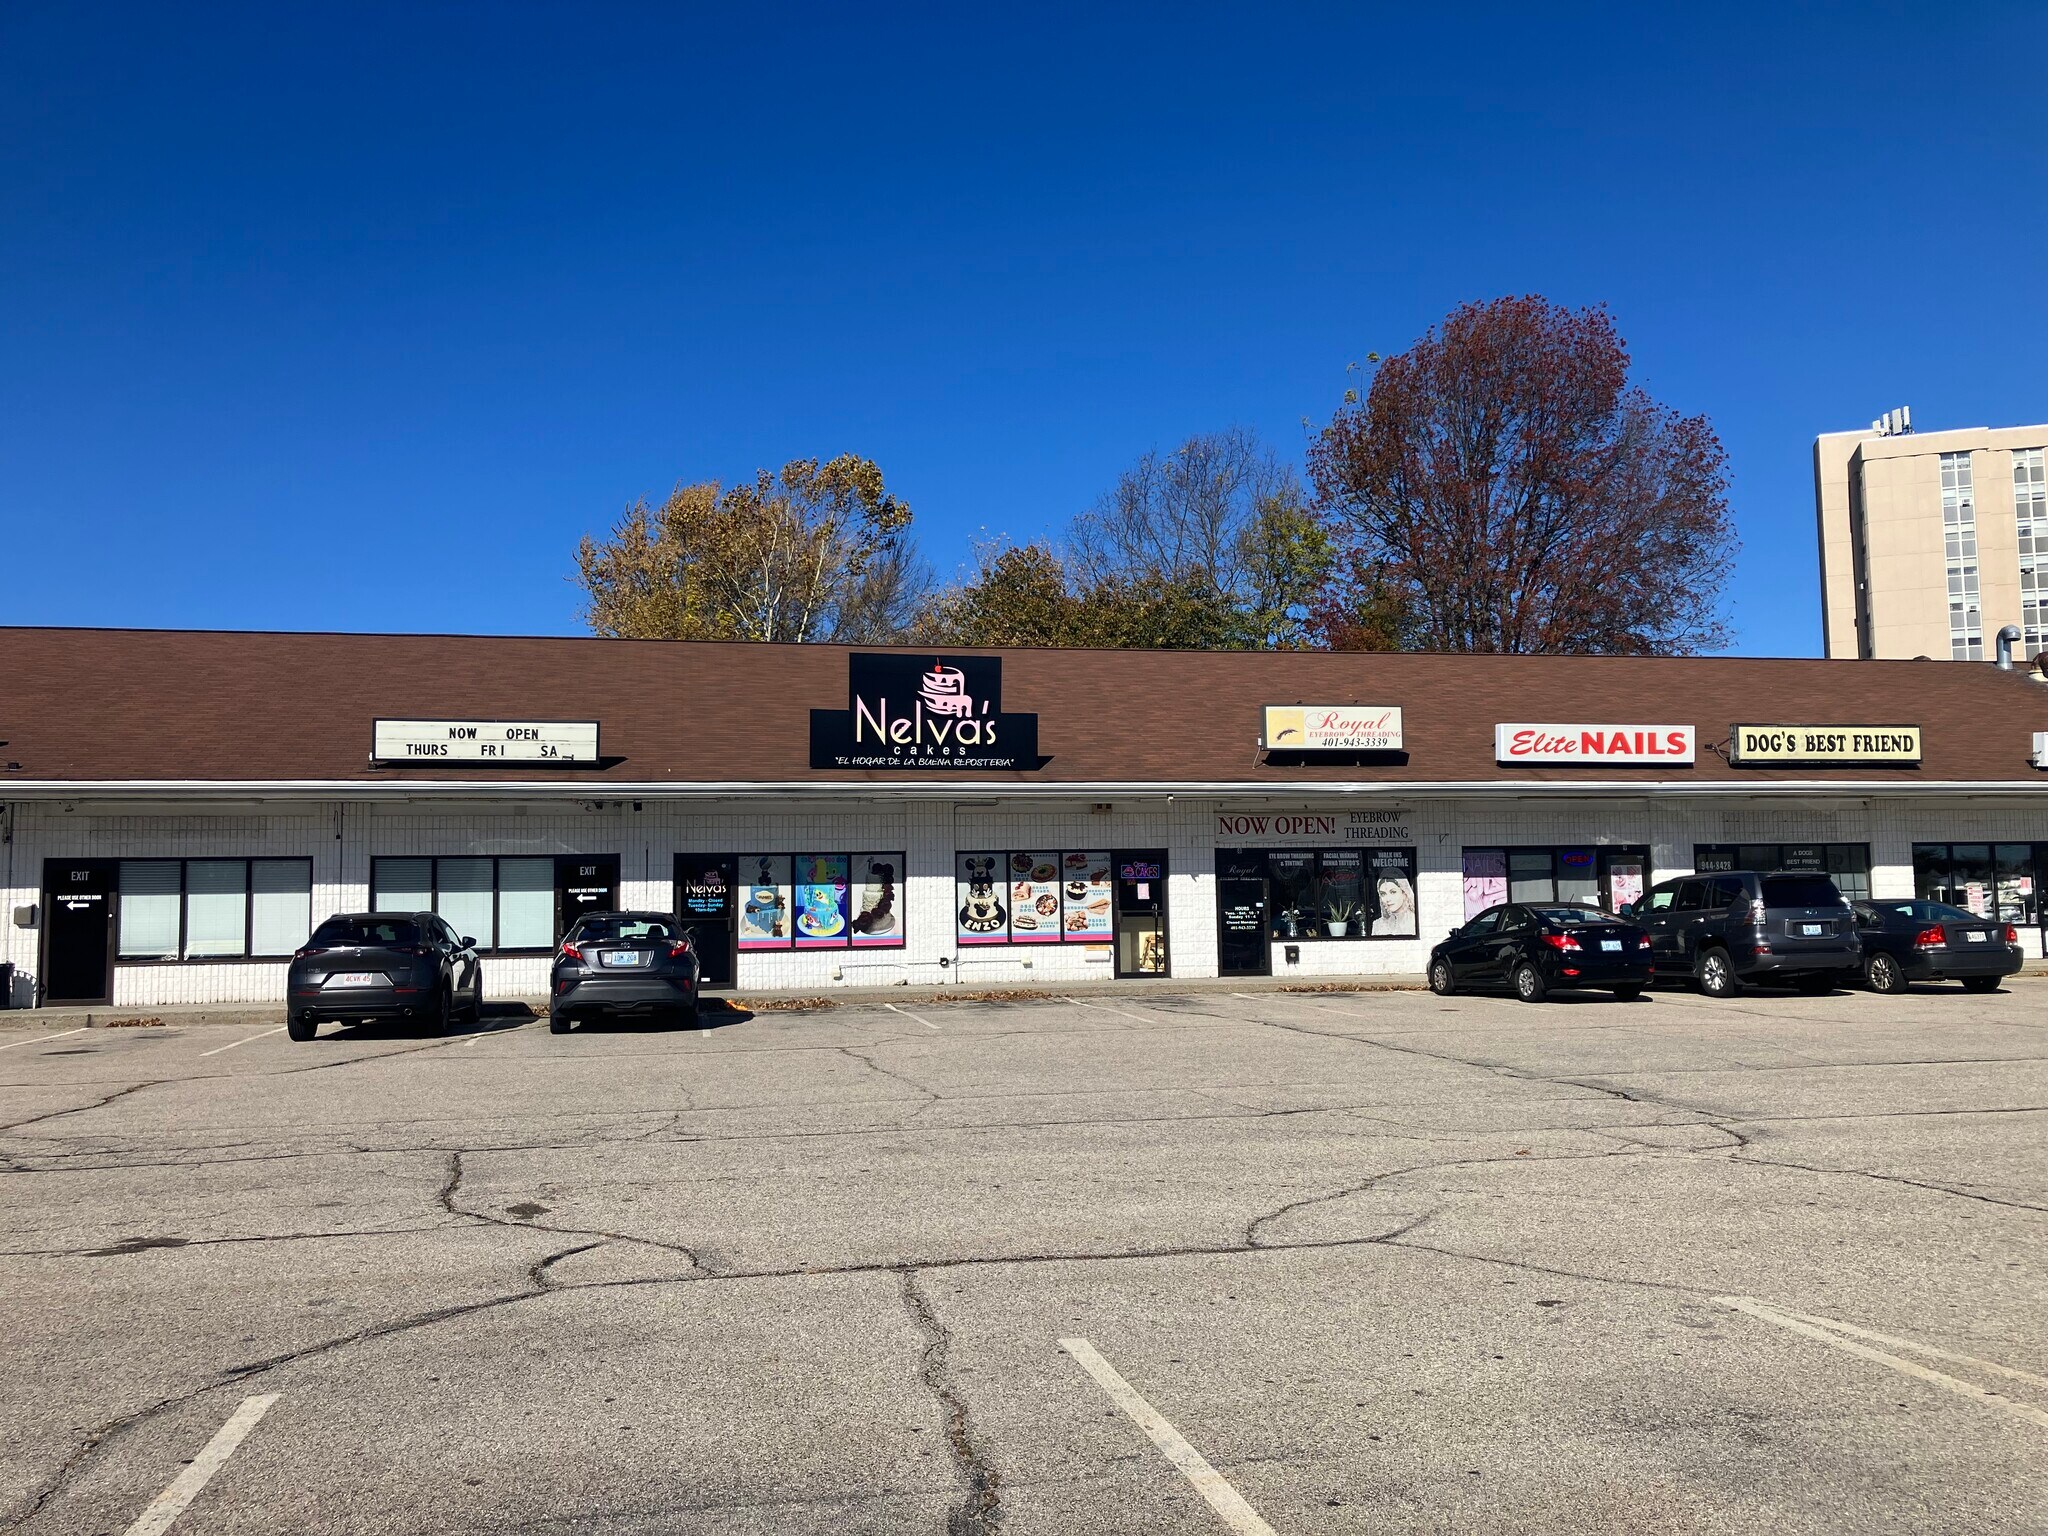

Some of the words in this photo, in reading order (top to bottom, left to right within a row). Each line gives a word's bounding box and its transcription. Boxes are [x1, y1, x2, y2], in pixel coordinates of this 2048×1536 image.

[856, 694, 997, 745] Nelva's
[1305, 710, 1392, 736] Royal
[449, 728, 478, 739] NOW
[506, 728, 539, 740] OPEN
[1322, 738, 1388, 747] 401-943-3339
[1509, 730, 1578, 756] Elite
[1581, 732, 1687, 755] NAILS
[1746, 731, 1796, 753] DOG'S
[1805, 734, 1847, 753] BEST
[1853, 734, 1915, 753] FRIEND
[406, 744, 448, 756] THURS
[481, 744, 504, 756] FRI
[894, 744, 966, 756] cakes
[852, 756, 886, 766] HOGAR
[887, 757, 901, 766] DE
[903, 757, 916, 766] LA
[918, 757, 952, 767] BUENA
[1350, 811, 1401, 824] EYEBROW
[1218, 816, 1270, 835] NOW
[1274, 816, 1336, 835] OPEN!
[1343, 826, 1409, 839] THREADING
[1372, 858, 1409, 867] WELCOME
[1463, 857, 1503, 873] NAILS
[1565, 855, 1589, 864] OPEN
[71, 871, 90, 881] EXIT
[580, 866, 597, 876] EXIT
[1135, 867, 1158, 877] CAKES
[1228, 864, 1259, 877] Royal
[964, 919, 1001, 931] ENZO
